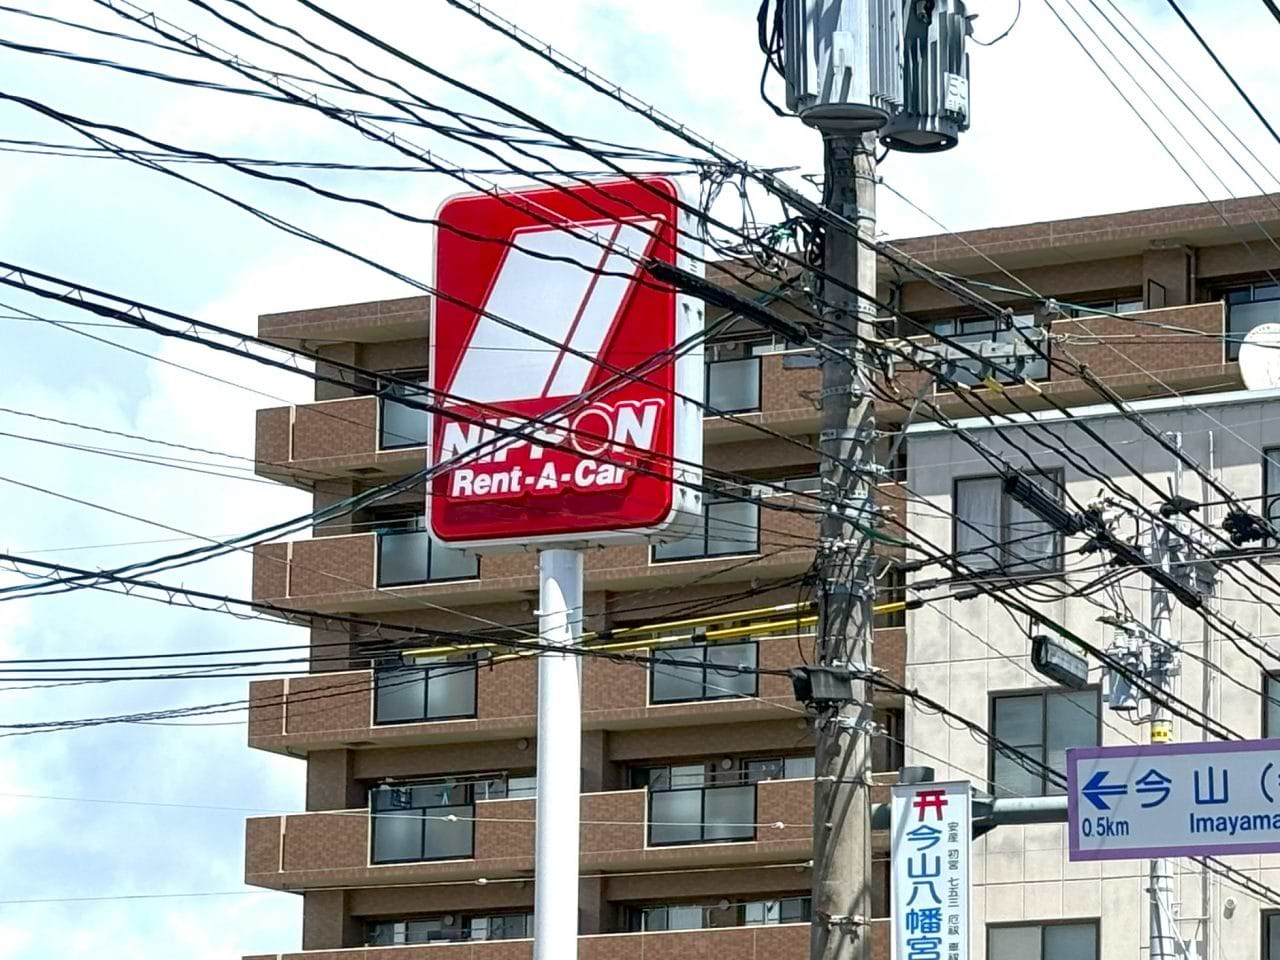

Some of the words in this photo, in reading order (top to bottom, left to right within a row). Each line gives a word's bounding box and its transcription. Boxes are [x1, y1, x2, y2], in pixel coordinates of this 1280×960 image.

[440, 403, 660, 465] NIPPON
[1082, 816, 1130, 838] 0.5km
[947, 876, 960, 908] 七五三
